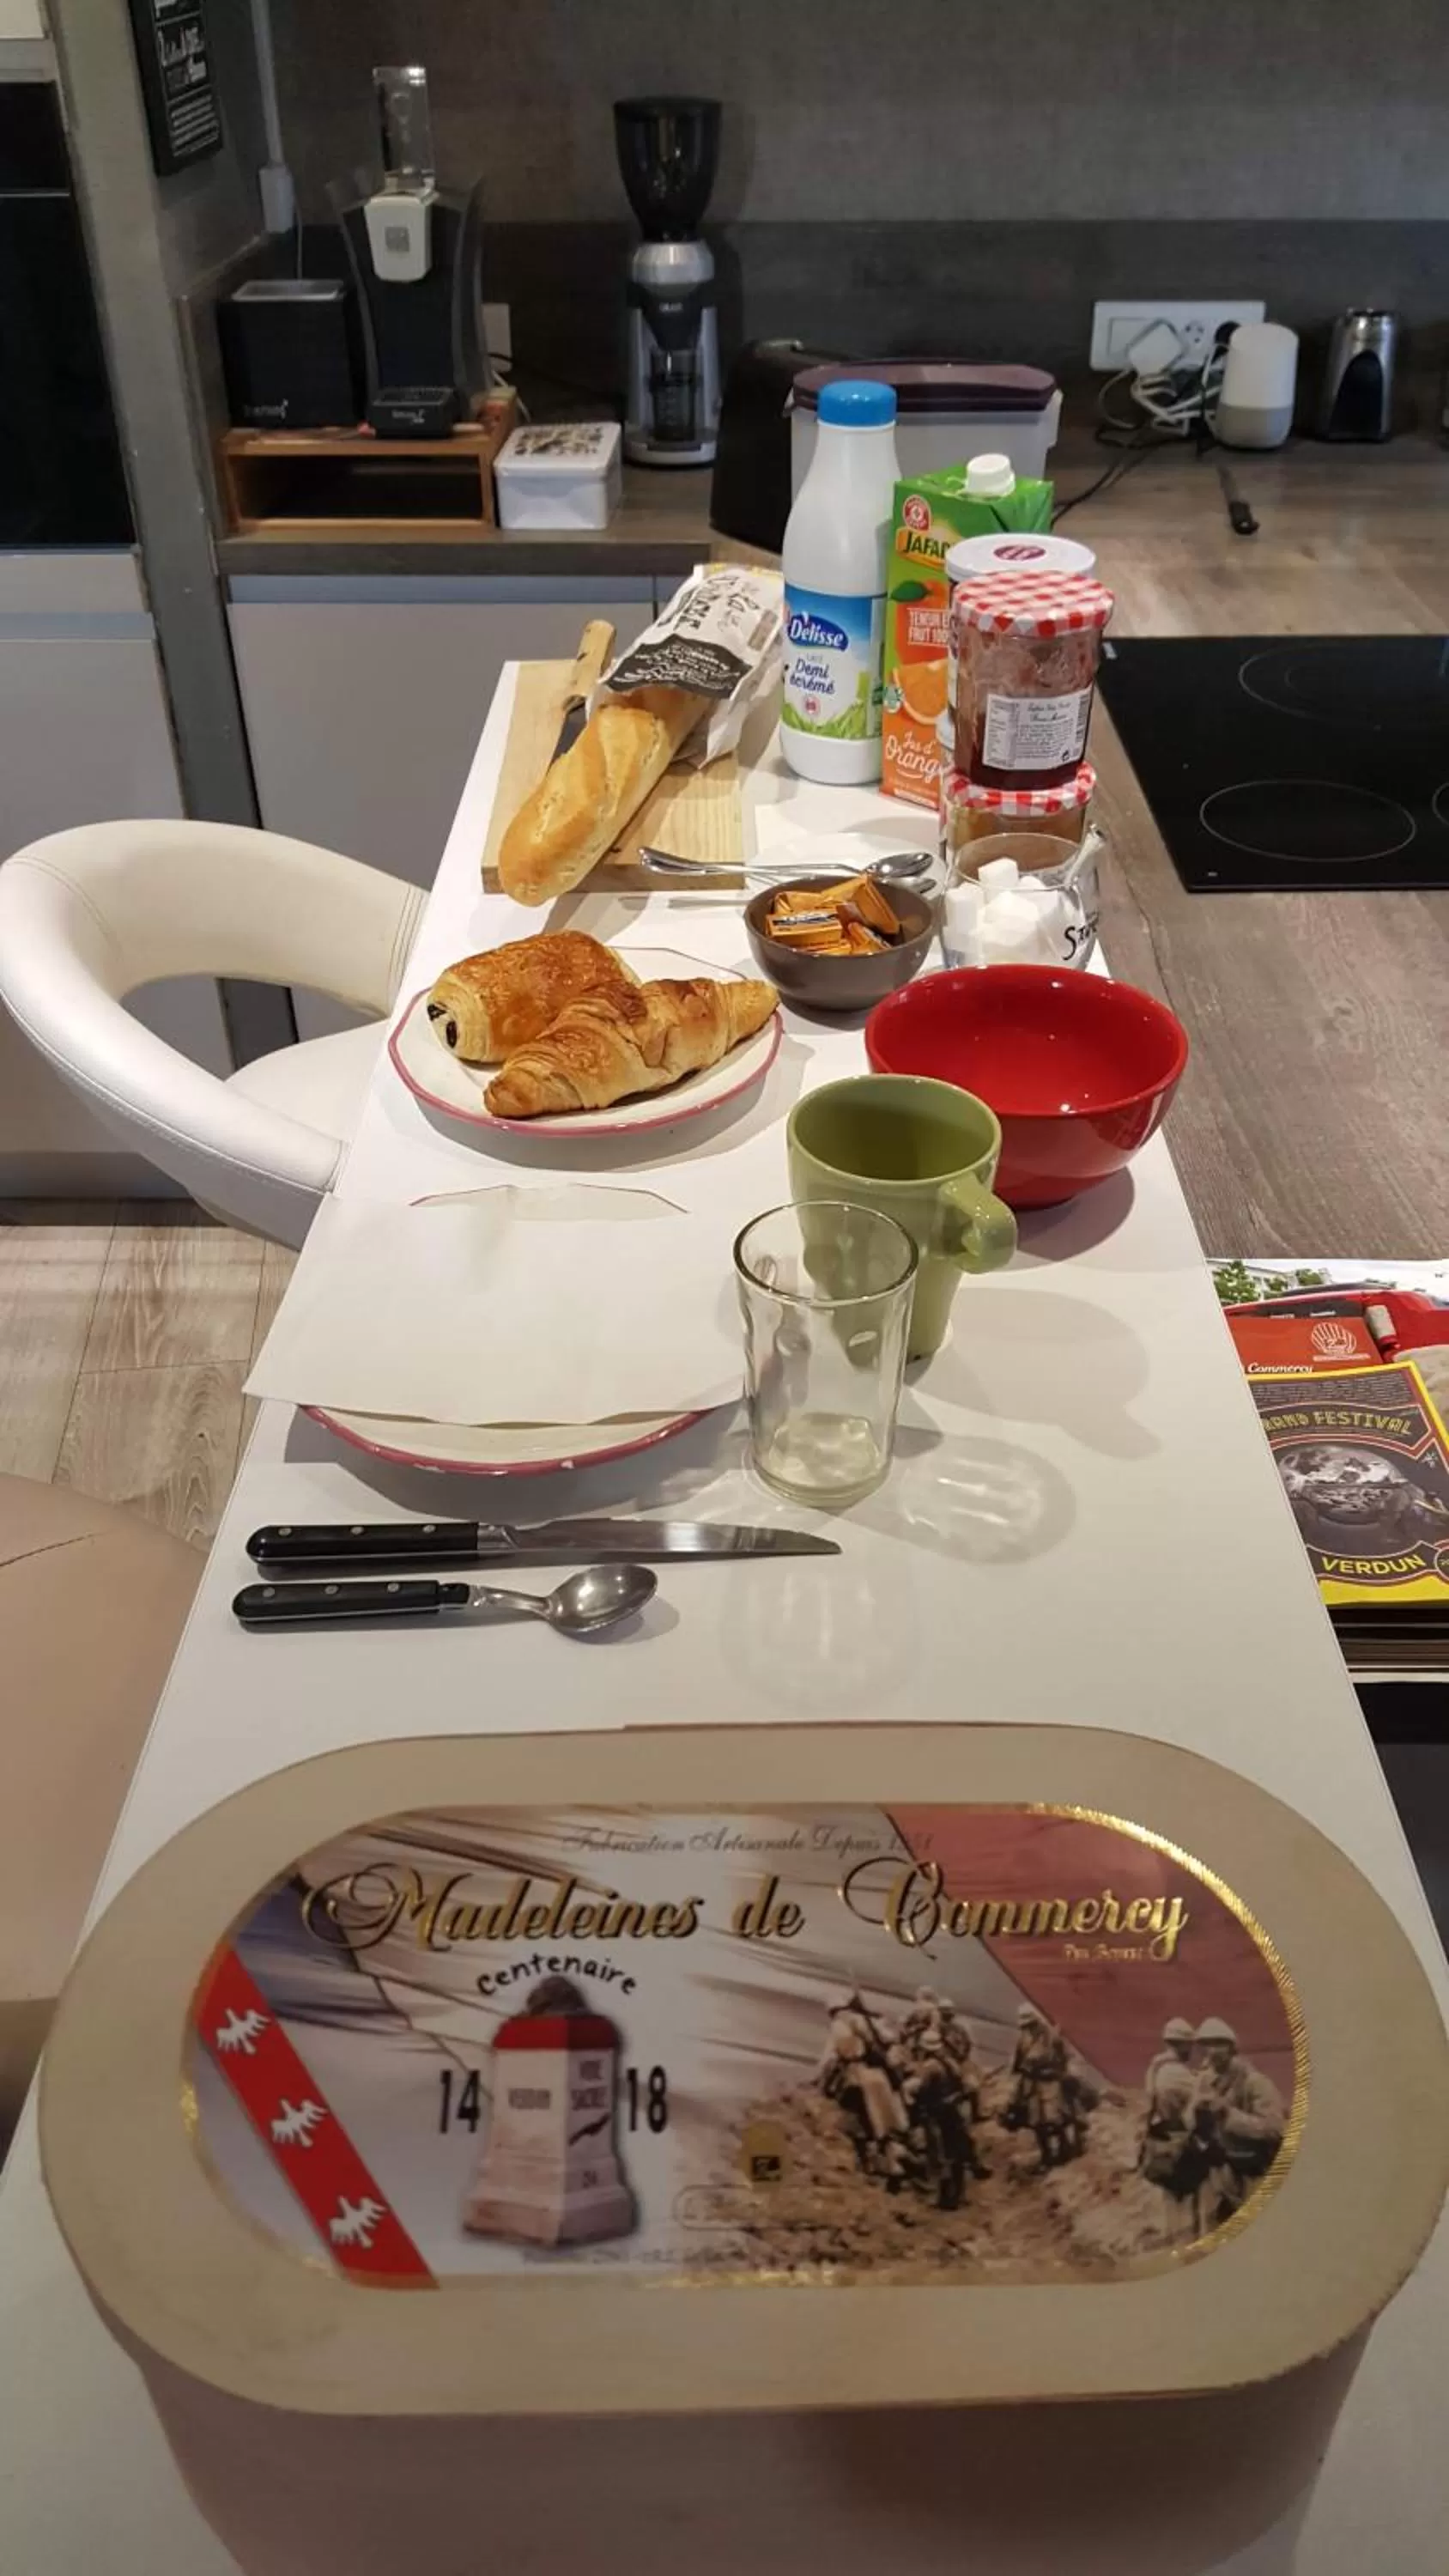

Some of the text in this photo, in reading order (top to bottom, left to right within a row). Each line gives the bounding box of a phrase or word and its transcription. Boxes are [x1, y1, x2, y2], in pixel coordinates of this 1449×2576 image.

[903, 530, 951, 560] JAFAD
[885, 735, 942, 784] Orang
[1263, 1411, 1412, 1436] RAND FESTIVAL
[1321, 1553, 1427, 1575] VERDUN
[300, 1856, 1188, 1963] Madeleines de Commercy
[439, 2065, 668, 2134] 14 18
